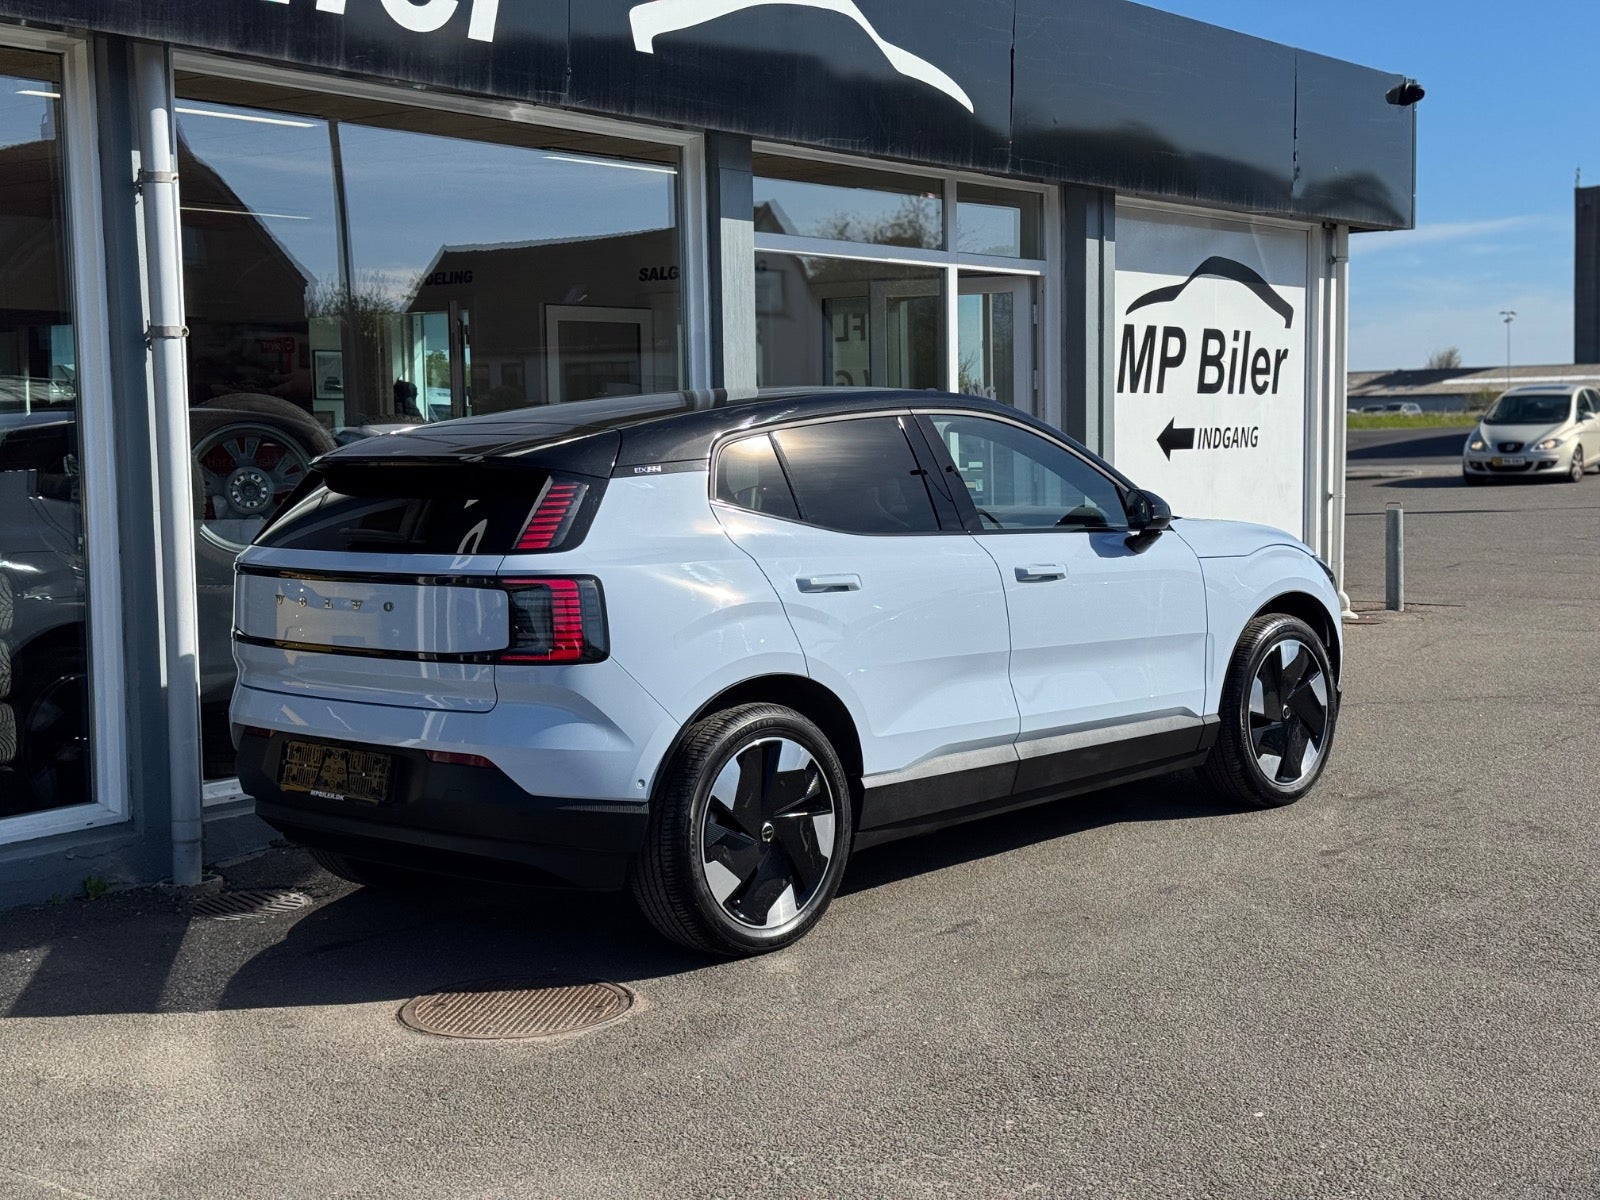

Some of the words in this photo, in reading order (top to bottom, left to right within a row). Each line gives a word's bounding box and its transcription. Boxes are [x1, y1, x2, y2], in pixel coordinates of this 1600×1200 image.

[1117, 324, 1187, 394] MP
[1197, 328, 1289, 395] Biler
[1197, 426, 1259, 450] INDGANG
[274, 594, 395, 613] VOLVO
